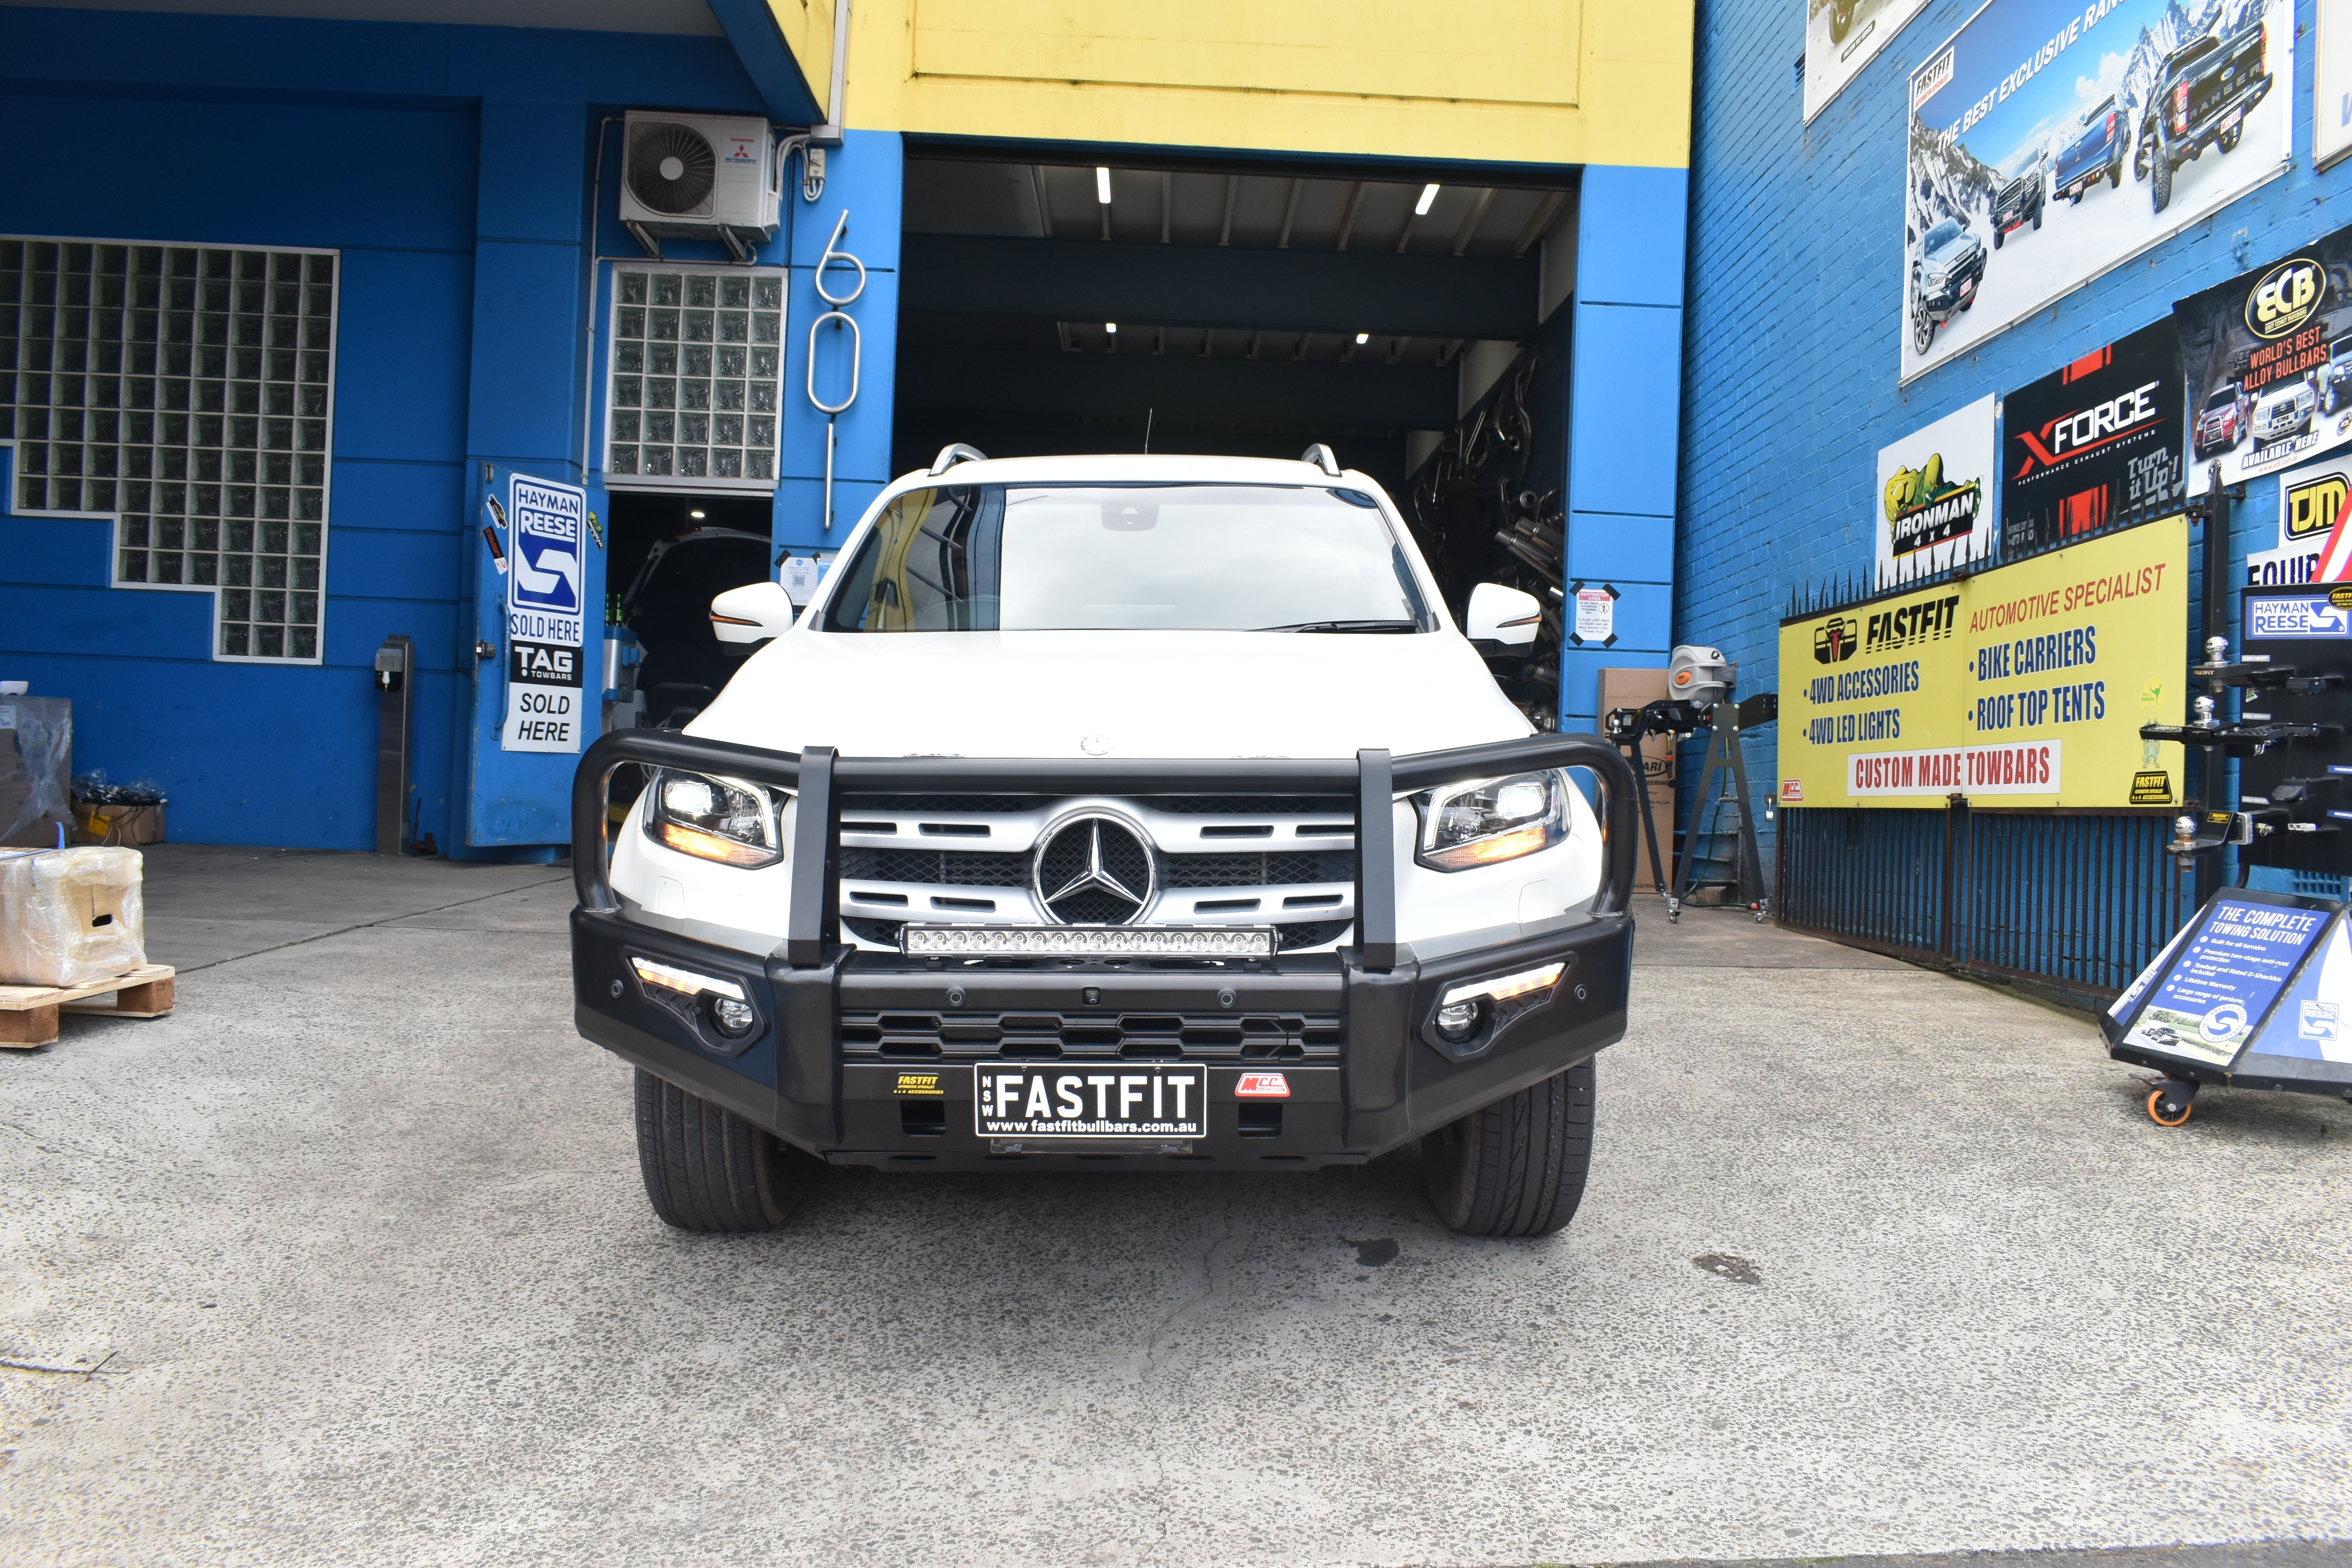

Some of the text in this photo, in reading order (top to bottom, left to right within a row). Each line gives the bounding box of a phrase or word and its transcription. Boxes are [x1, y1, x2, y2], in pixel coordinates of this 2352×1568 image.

[1916, 51, 1952, 98] FASTFIT
[1937, 118, 1961, 154] THE
[1962, 87, 1997, 134] BEST
[1998, 16, 2081, 104] EXCLUSIVE
[2190, 63, 2259, 120] RANGER
[2221, 118, 2230, 130] MCC
[2257, 267, 2315, 322] ECB
[2265, 308, 2307, 332] EAST COAST BULLBARS
[2250, 326, 2320, 369] WORLD'S BEST
[2244, 343, 2327, 391] ALLOY BULLBARS
[2011, 381, 2156, 480] XFORCE
[2018, 430, 2155, 486] PERFORMANCE EXHAUST SYSTEMS
[2242, 431, 2318, 468] AVAILABLE HERE
[2128, 446, 2169, 479] Turn
[2259, 456, 2298, 472] www.ecb.com.au
[519, 488, 578, 514] HAYMAN
[2129, 480, 2141, 500] it
[521, 510, 575, 542] REESE
[1896, 492, 1974, 540] IRONMAN
[588, 520, 603, 547] IRONMAN
[1914, 535, 1921, 547] 4
[1943, 524, 1951, 537] 4
[1969, 563, 2166, 633] AUTOMOTIVE SPECIALIST
[2255, 602, 2309, 614] HAYMAN
[511, 613, 580, 642] SOLD HERE
[1866, 595, 1960, 654] FASTFIT
[2255, 615, 2308, 633] REESE
[514, 646, 573, 677] TAG
[1978, 625, 2096, 681] BIKE CARRIERS
[531, 670, 572, 681] TOWBARS
[1810, 660, 1919, 705] 4WD ACCESSORIES
[520, 693, 570, 715] SOLD
[1977, 680, 2105, 731] ROOF TOP TENTS
[519, 721, 570, 742] HERE
[1809, 708, 1900, 745] 4WD LED LIGHTS
[1856, 746, 2050, 789] CUSTOM MADE TOWBARS
[2136, 776, 2166, 788] FASTFIT
[2218, 906, 2316, 931] THE COMPLETE
[2209, 921, 2306, 945] TOWING SOLUTION
[2200, 955, 2230, 964] protection
[2204, 949, 2289, 967] Premium two-stage anti-rust
[2243, 943, 2267, 951] terrains
[2184, 977, 2236, 991] Lifetime Warranty
[2190, 968, 2216, 977] included
[2194, 963, 2216, 972] Towball
[2229, 968, 2247, 976] Rated
[2247, 973, 2282, 982] D-Shackles
[2173, 994, 2206, 1004] accessories
[2177, 987, 2194, 996] Large
[2210, 1006, 2234, 1015] HAYMAN
[2212, 1025, 2242, 1040] WARRANTY
[982, 1076, 993, 1116] NSW
[996, 1075, 1194, 1118] FASTFIT
[1241, 1077, 1283, 1091] MCC
[987, 1120, 1197, 1132] www fastfitbullbars.com.au
